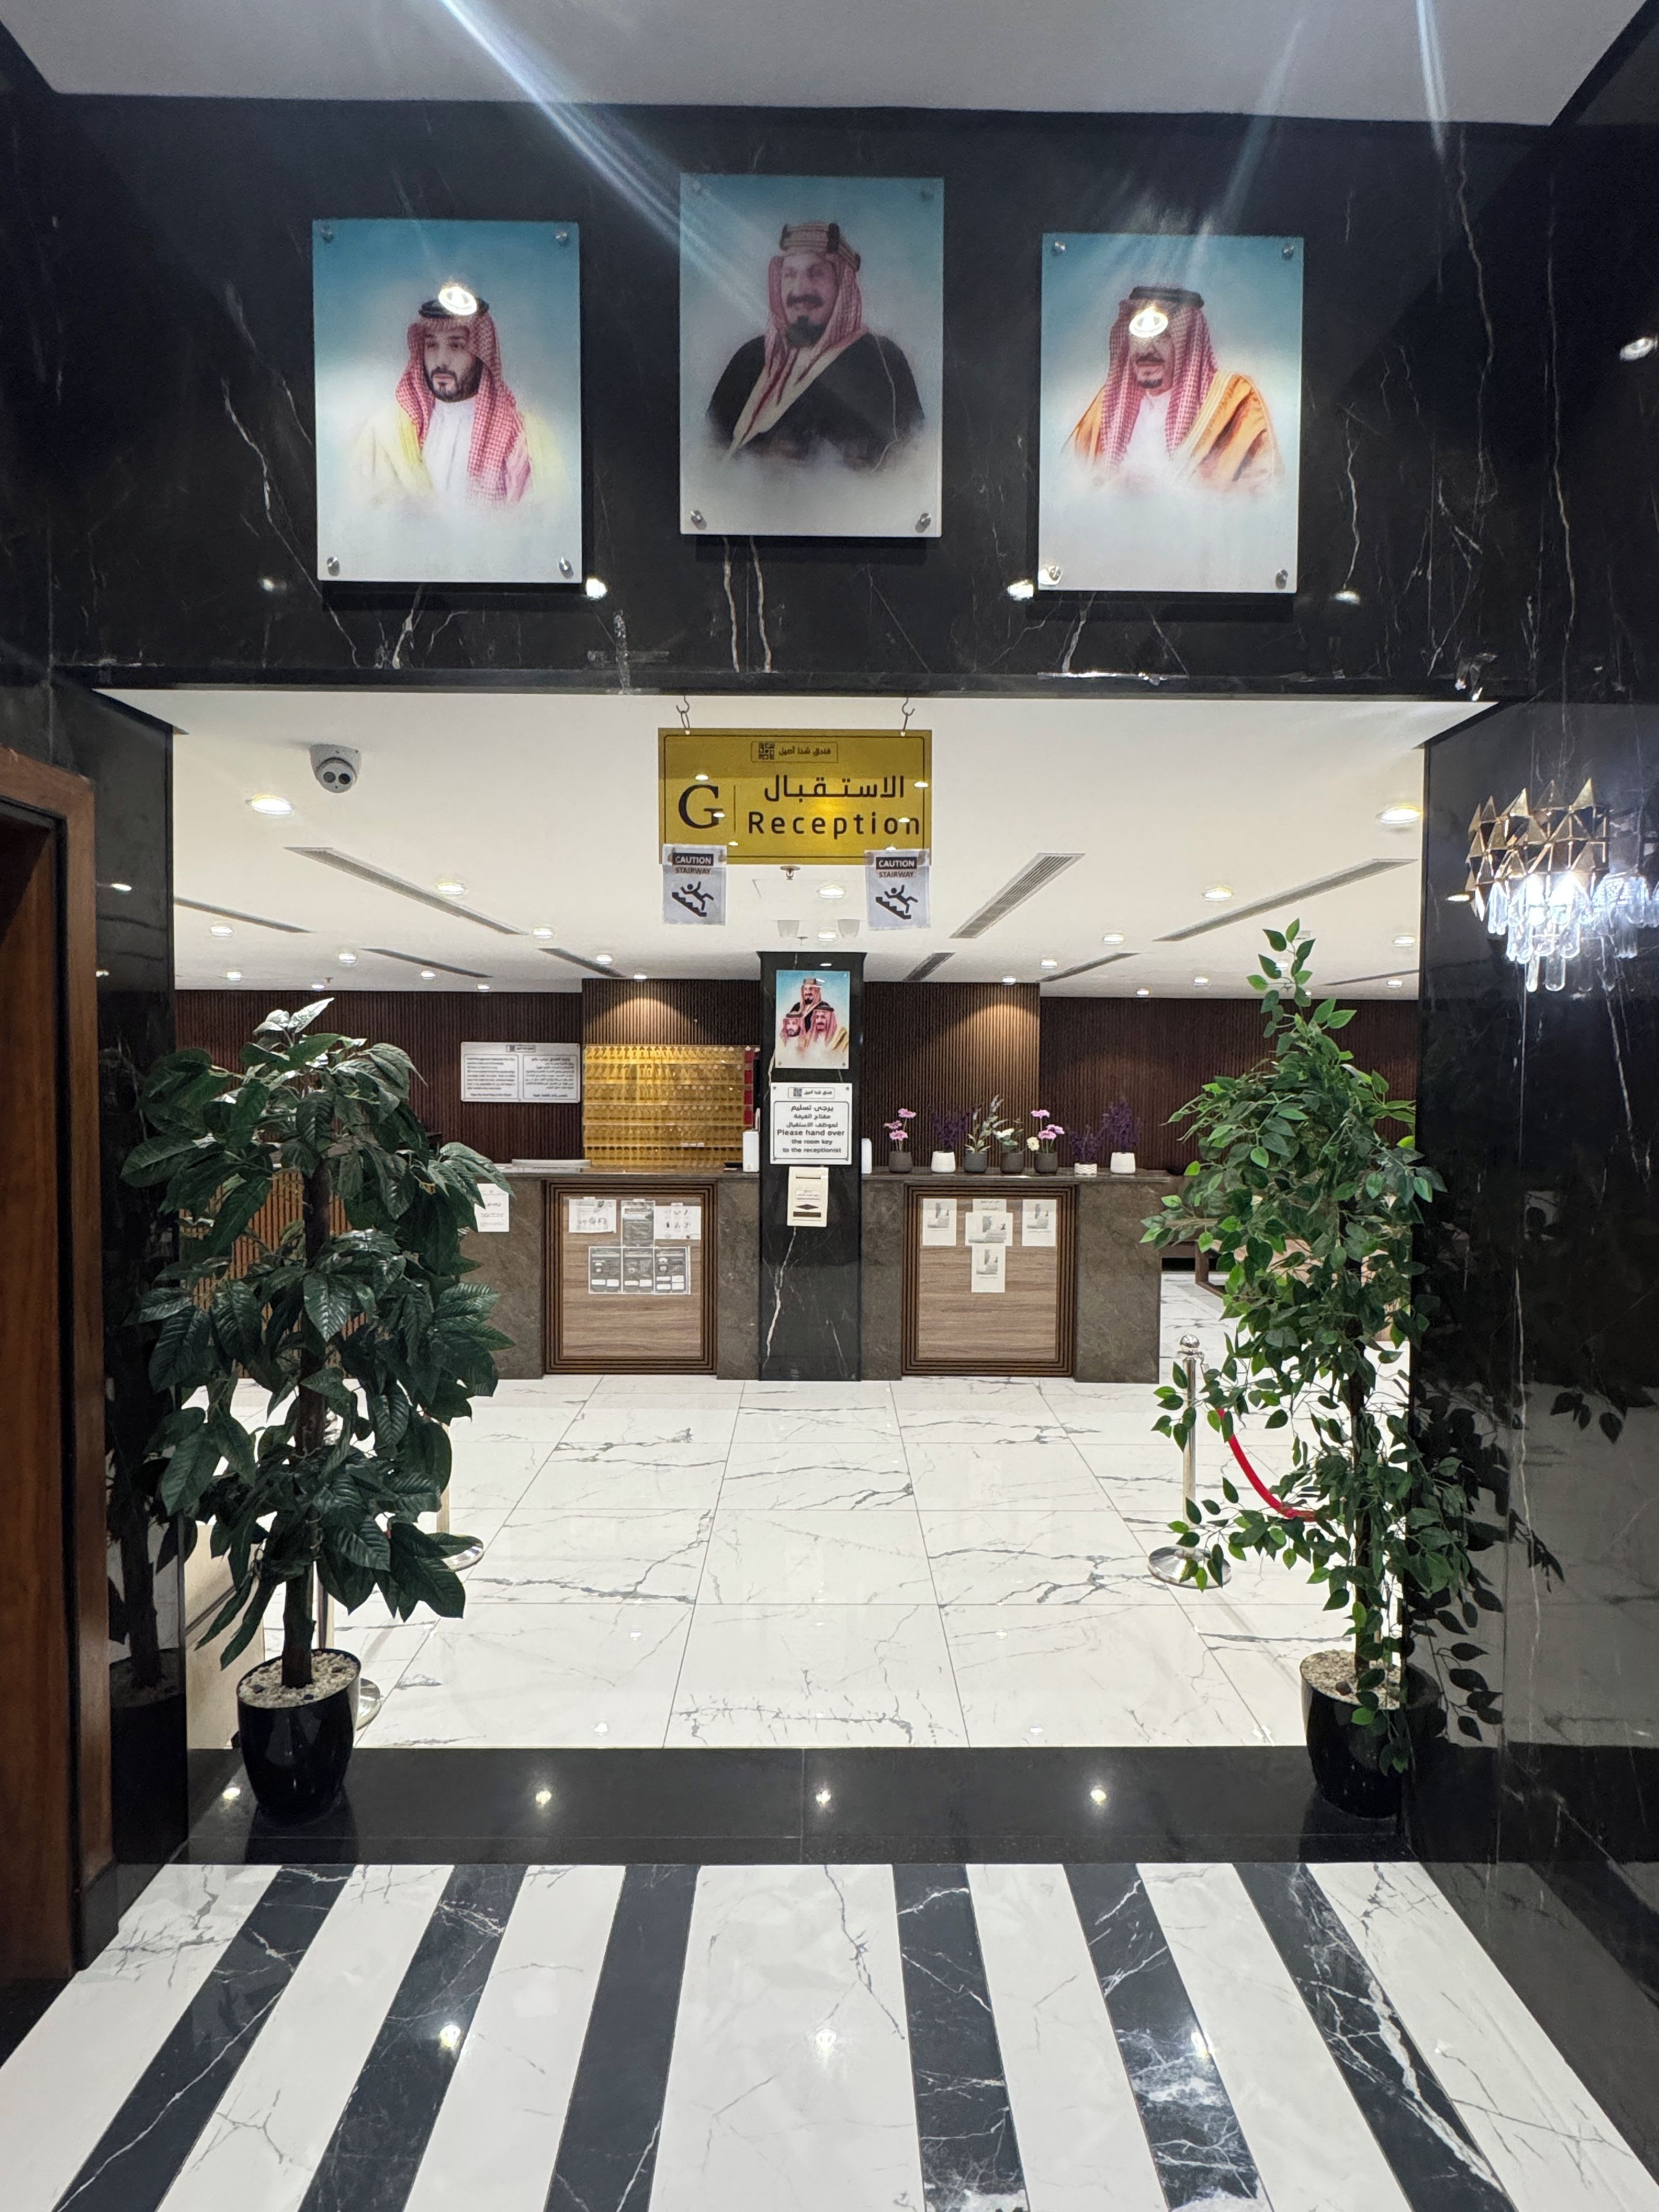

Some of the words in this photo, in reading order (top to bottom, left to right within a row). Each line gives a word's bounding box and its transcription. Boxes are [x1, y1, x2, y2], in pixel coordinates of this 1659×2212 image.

[813, 748, 831, 756] فندق
[764, 775, 904, 802] الاستقبال
[678, 784, 724, 830] G
[748, 812, 920, 840] Reception
[675, 855, 711, 864] CAUTION
[878, 860, 915, 868] CAUTION
[675, 866, 711, 874] STAIRWAY
[790, 1104, 812, 1112] تسليم
